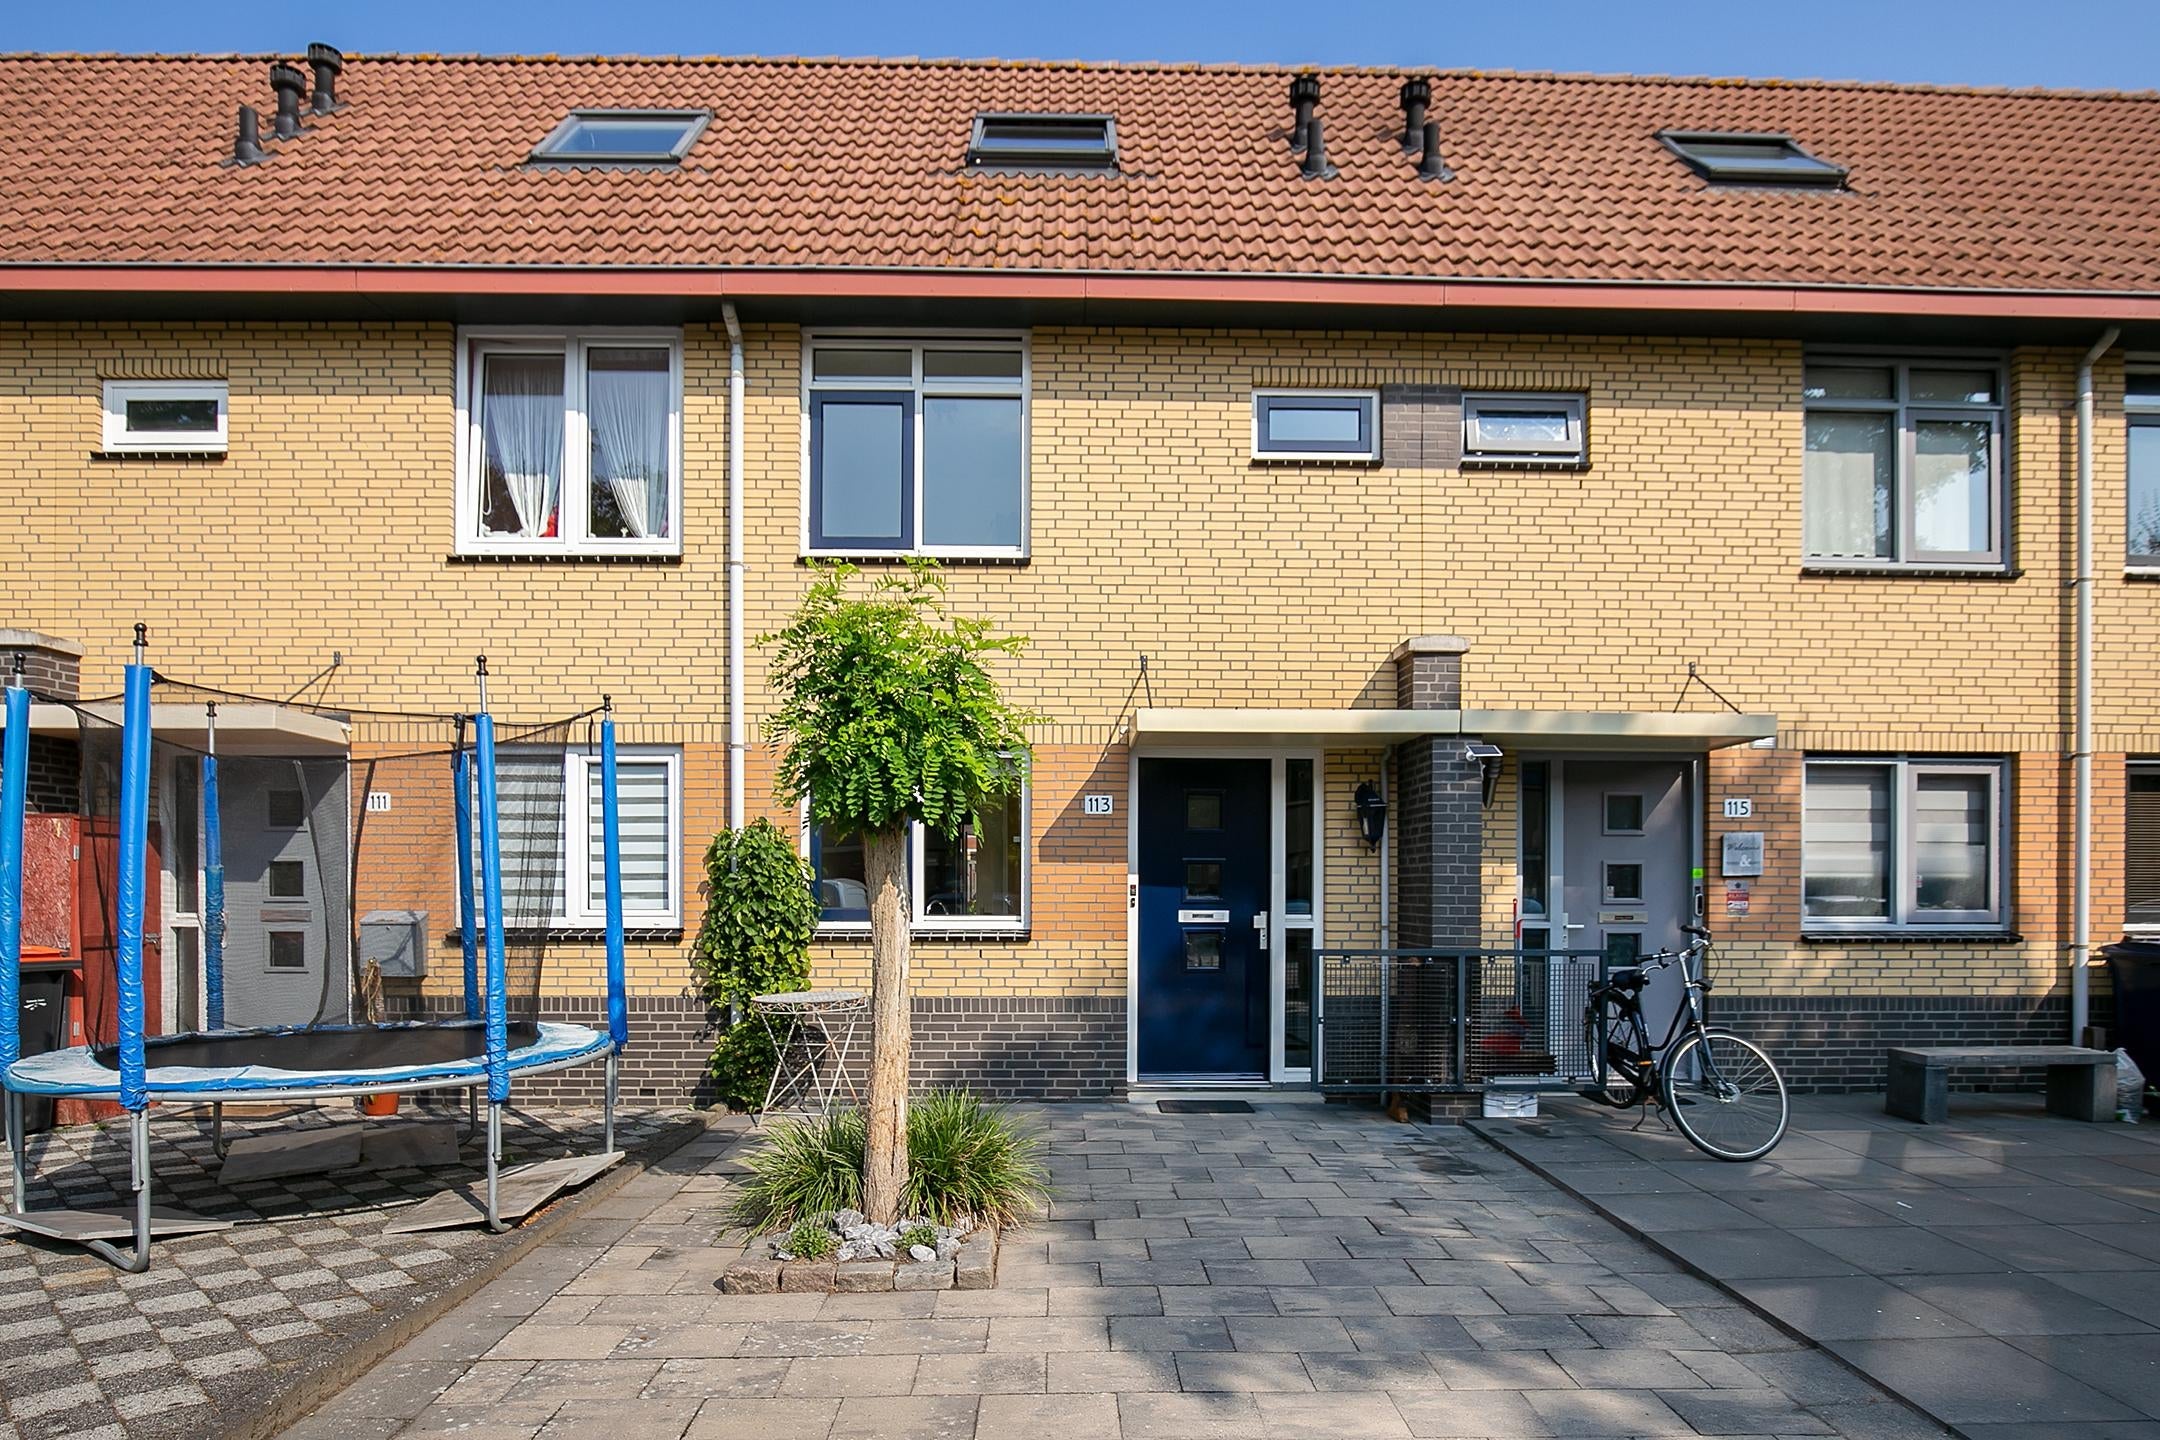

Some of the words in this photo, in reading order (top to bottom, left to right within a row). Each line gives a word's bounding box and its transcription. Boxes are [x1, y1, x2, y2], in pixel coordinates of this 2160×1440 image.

[370, 795, 387, 809] 111
[1088, 797, 1110, 812] 113
[1728, 801, 1749, 815] 115
